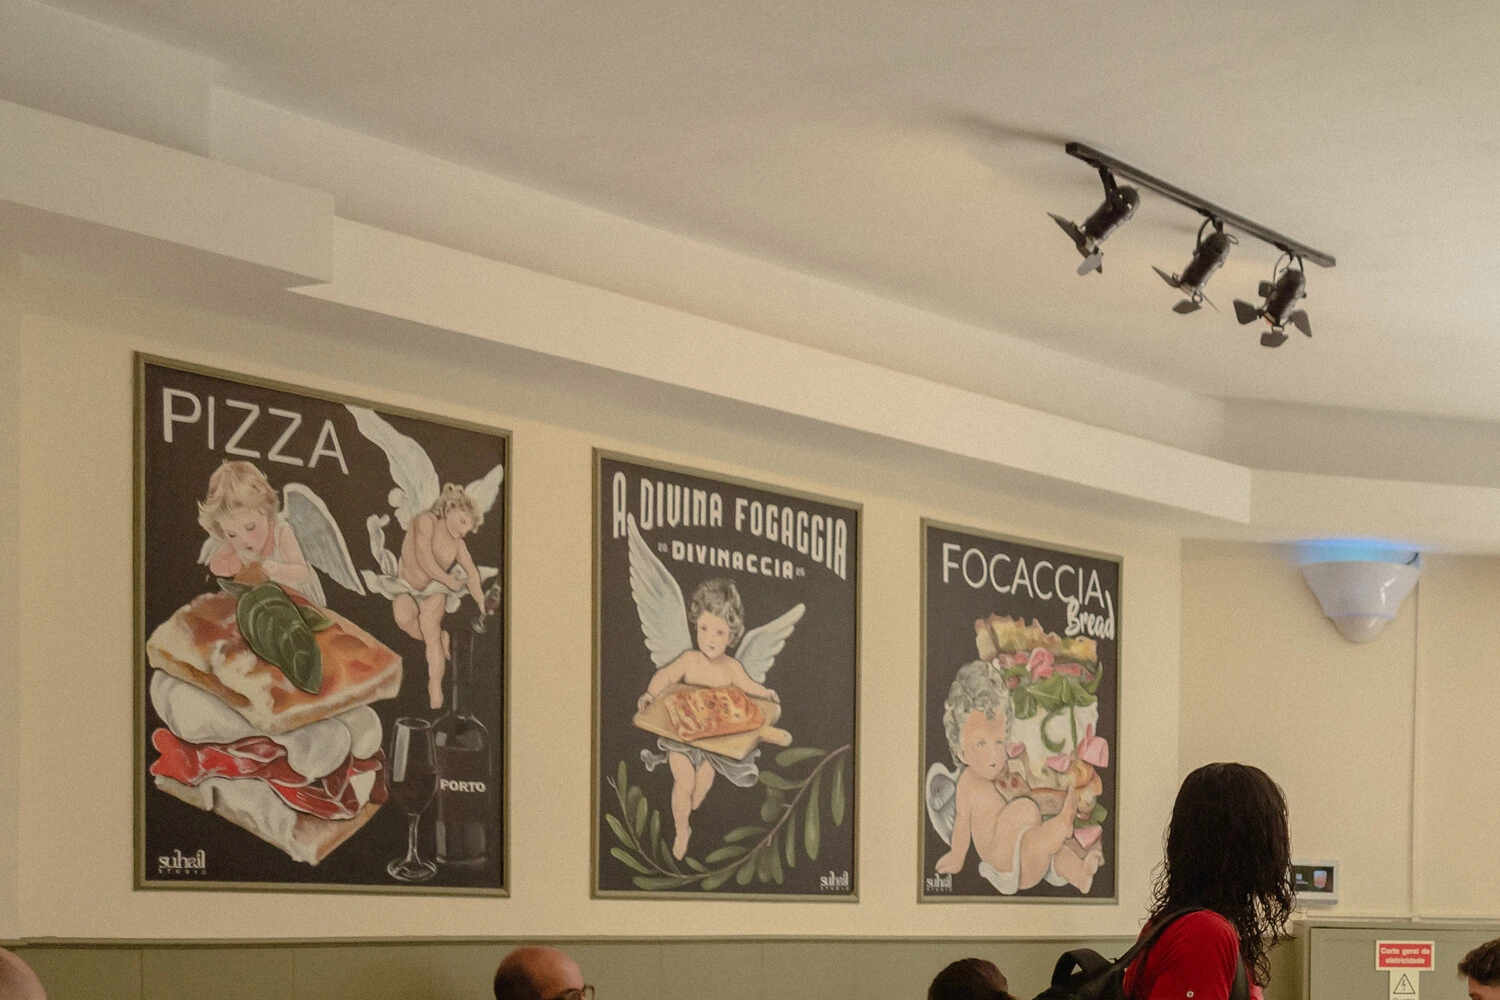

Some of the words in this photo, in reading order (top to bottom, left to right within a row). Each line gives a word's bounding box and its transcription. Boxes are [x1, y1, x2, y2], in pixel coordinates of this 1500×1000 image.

[163, 387, 349, 475] PIZZA
[612, 471, 627, 539] A
[640, 478, 723, 531] DIVINA
[672, 540, 793, 579] DIVINACCIA
[942, 543, 1105, 608] FOCACCIA
[1065, 590, 1115, 640] Bread
[440, 779, 486, 793] PORTO
[159, 848, 206, 869] suhail
